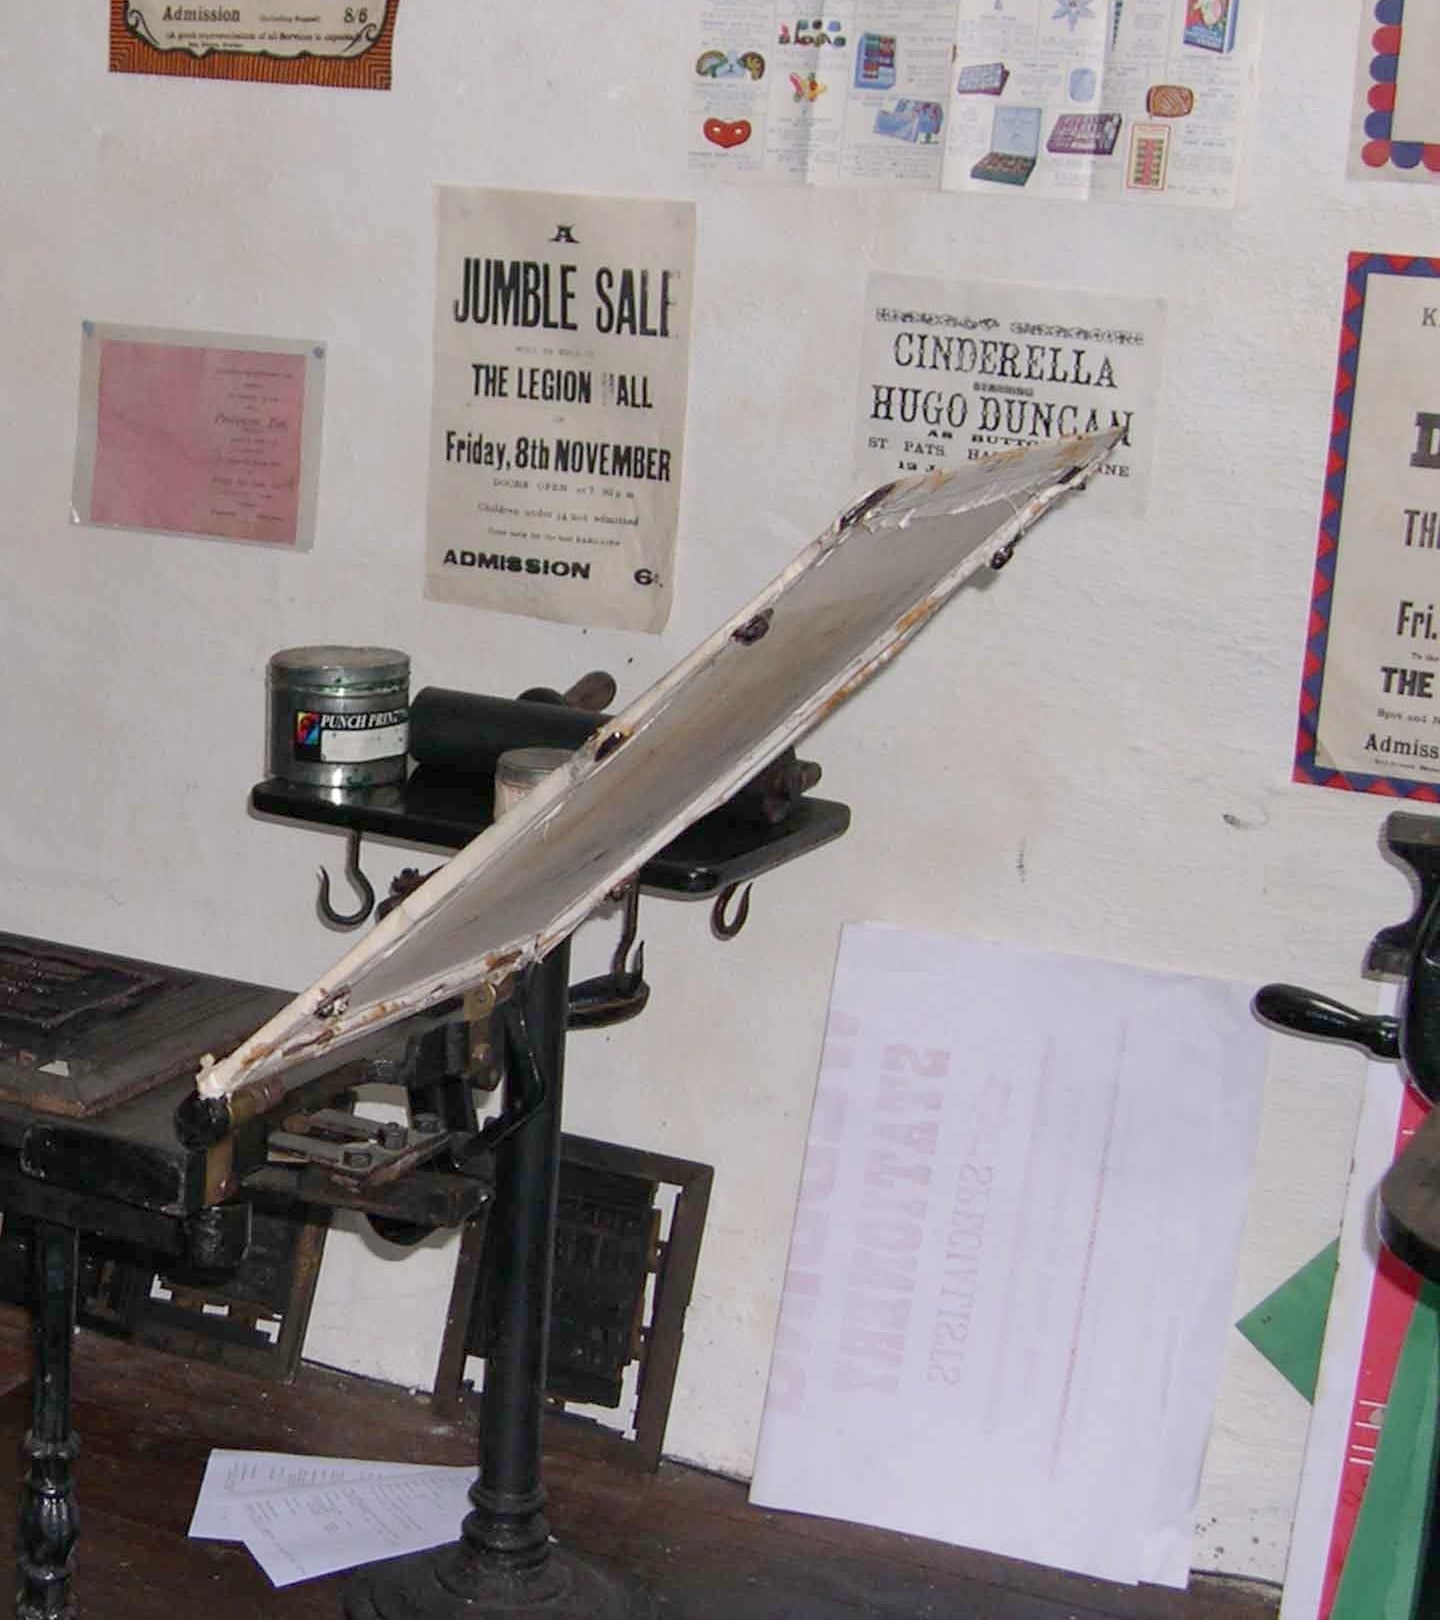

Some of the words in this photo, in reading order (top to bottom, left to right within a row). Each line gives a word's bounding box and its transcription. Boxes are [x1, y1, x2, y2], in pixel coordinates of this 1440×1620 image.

[162, 5, 240, 22] Admission
[548, 224, 580, 244] A
[453, 256, 579, 331] JUMBLE
[594, 266, 680, 338] SALE
[1422, 307, 1440, 327] K
[893, 331, 1118, 389] CINDERELLA
[471, 363, 509, 397] THE
[517, 367, 592, 404] LEGION
[870, 384, 968, 429] HUGO
[978, 396, 1135, 447] DUNCAN
[446, 430, 511, 471] Friday,
[515, 436, 550, 471] 8th
[554, 439, 672, 483] NOVEMBER
[903, 440, 945, 456] PATS
[443, 548, 591, 580] ADMISSION
[1396, 600, 1437, 640] Fri.
[1380, 666, 1435, 699] THE
[320, 713, 368, 729] PUNCH
